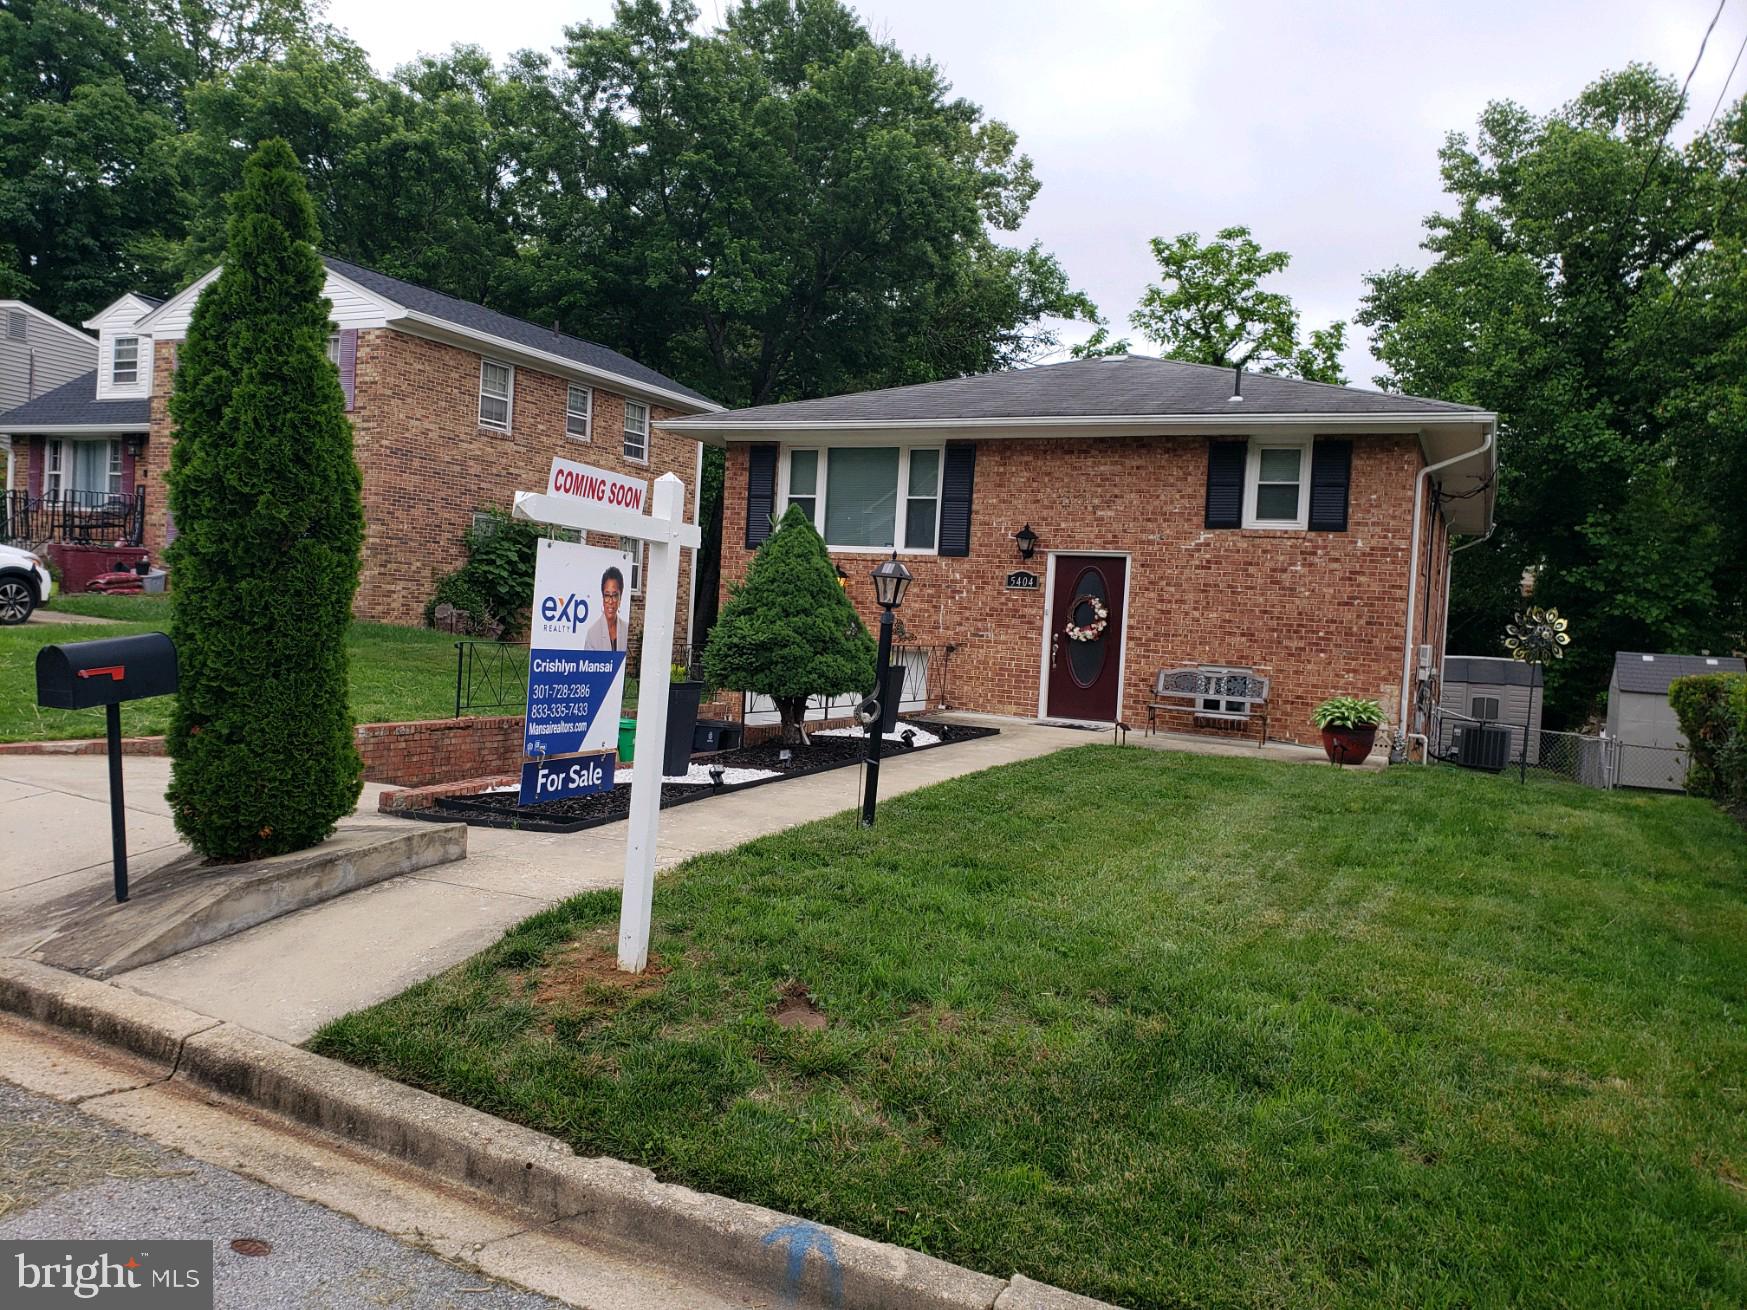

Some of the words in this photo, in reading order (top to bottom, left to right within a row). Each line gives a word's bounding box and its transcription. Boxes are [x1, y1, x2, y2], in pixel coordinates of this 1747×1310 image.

[554, 468, 606, 502] COMING
[608, 482, 642, 510] SOON
[1010, 576, 1034, 587] 5404
[543, 624, 570, 633] REALTY
[533, 658, 577, 675] Crishlyn
[578, 659, 613, 672] Mansai
[532, 684, 590, 699] 301-728-2386
[531, 702, 588, 719] 833-335-7433
[528, 720, 588, 736] Mansairealtors.com
[536, 768, 566, 793] For
[568, 761, 603, 789] Sale
